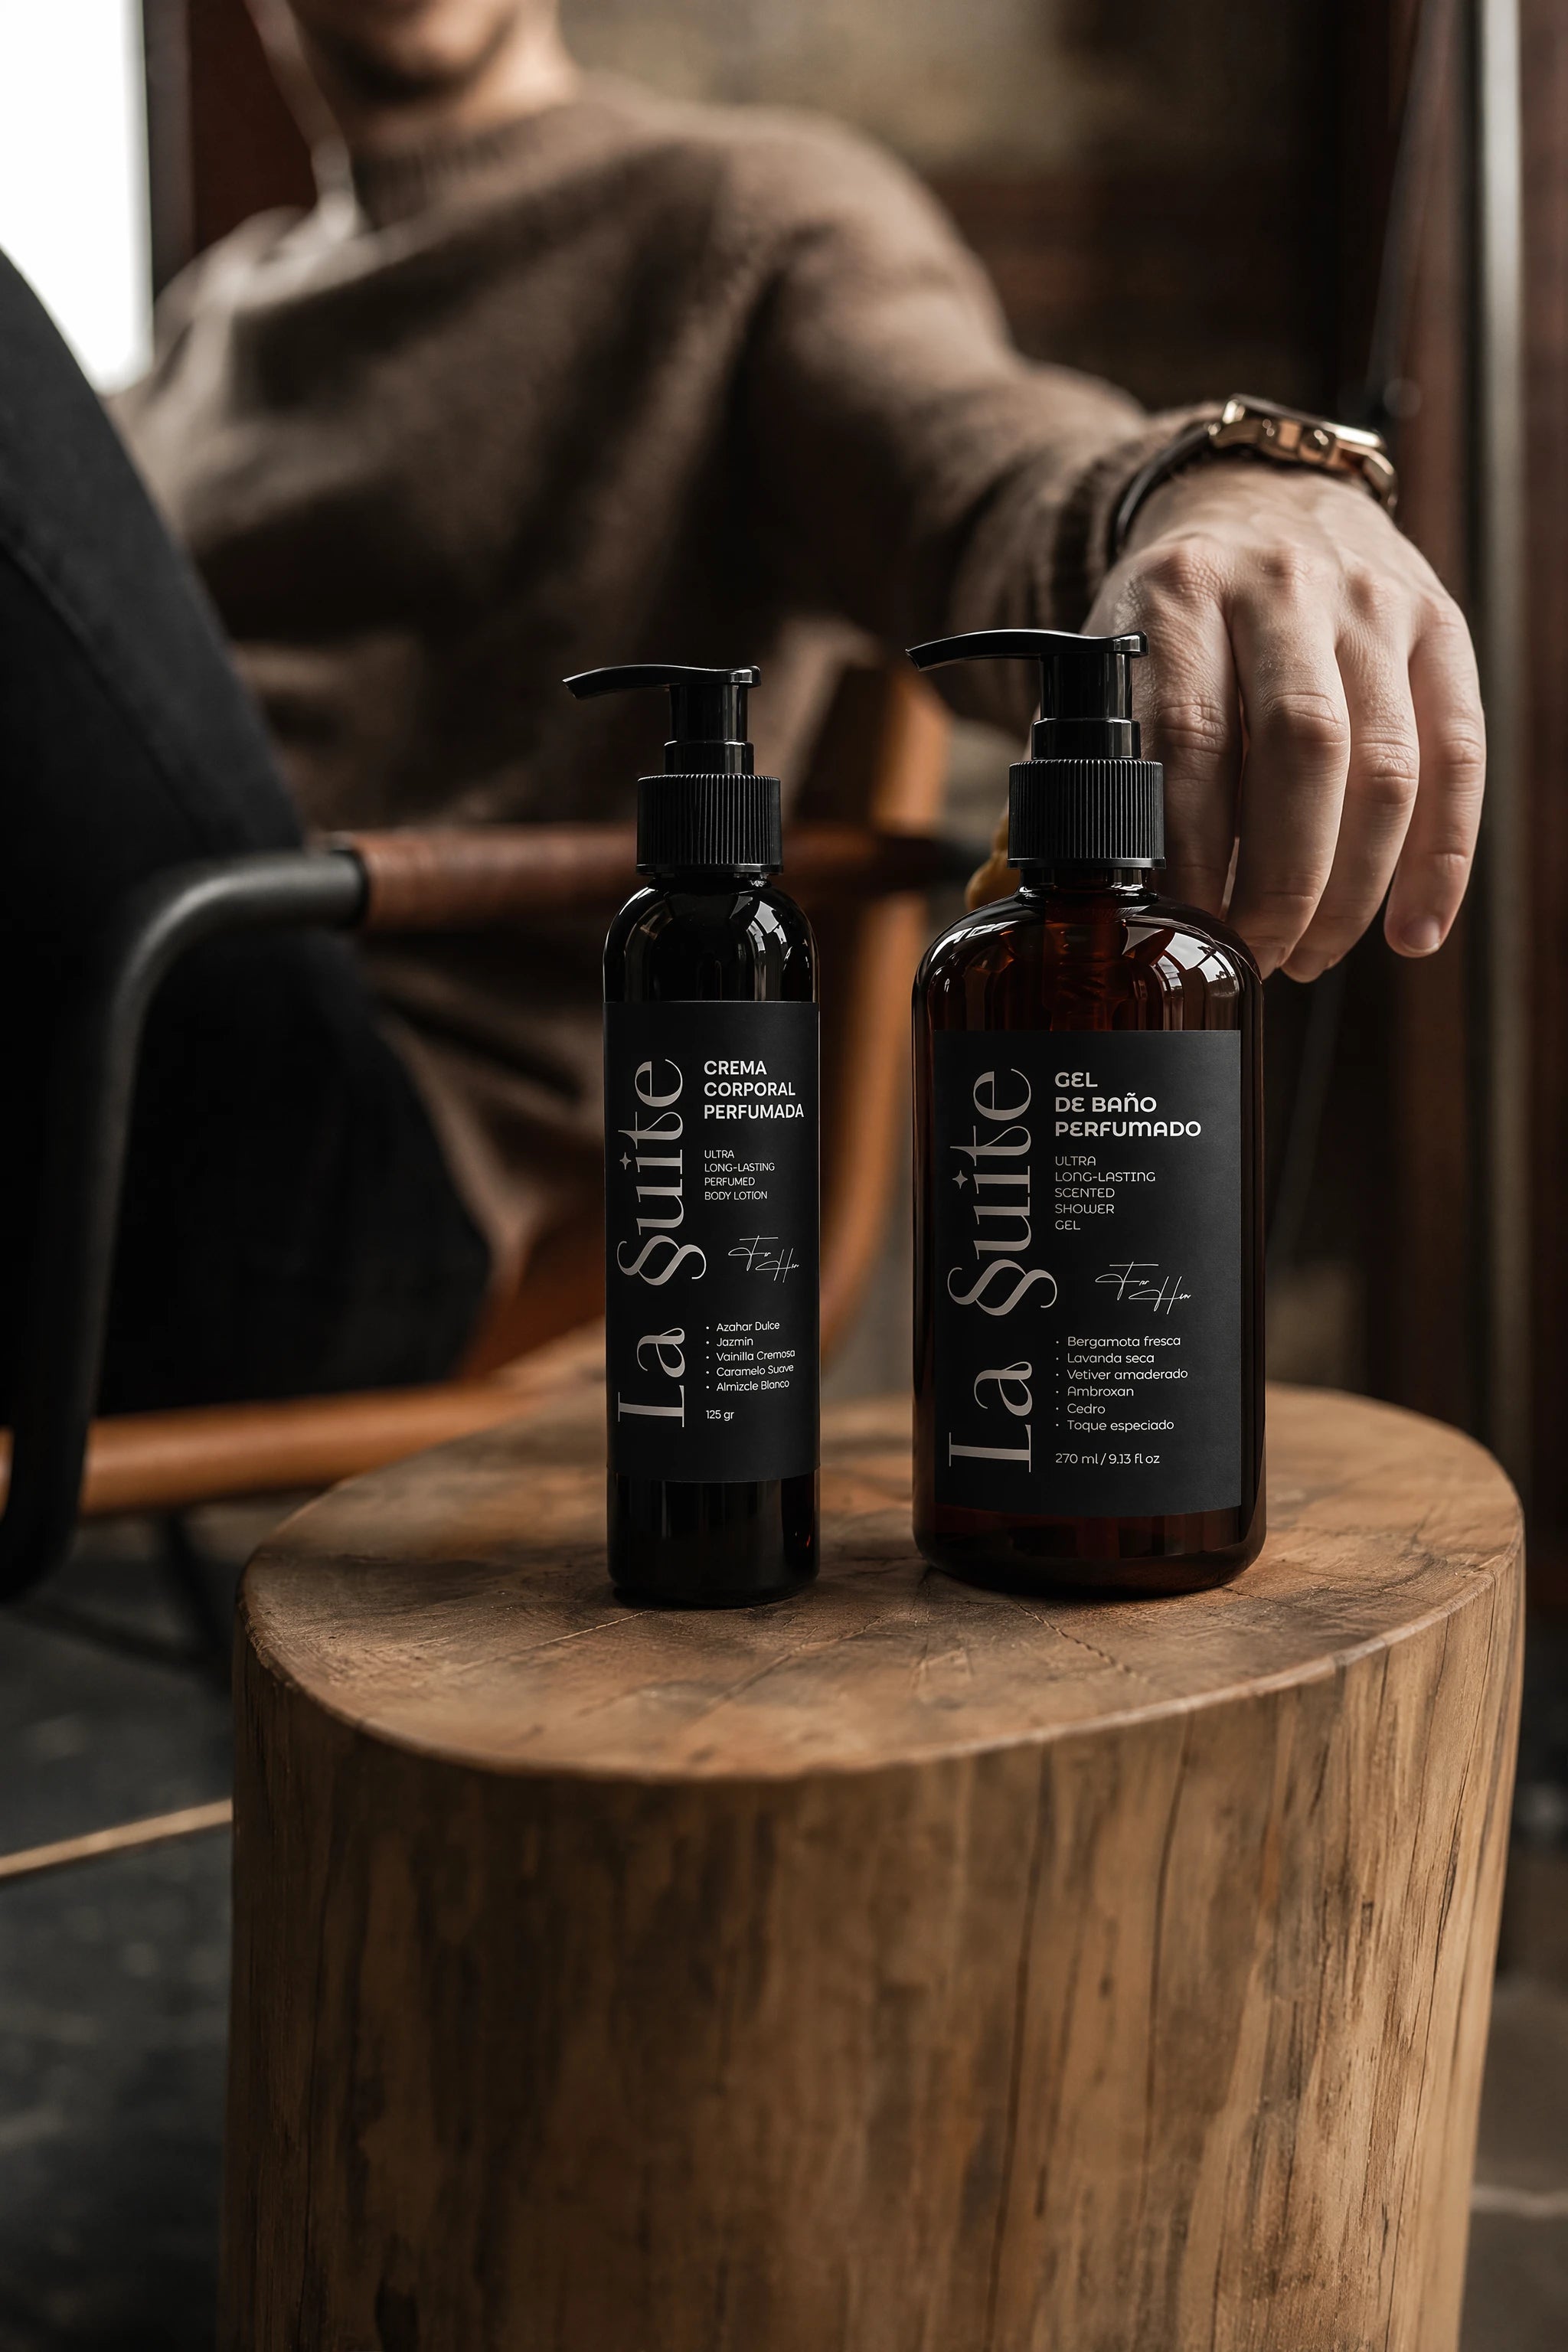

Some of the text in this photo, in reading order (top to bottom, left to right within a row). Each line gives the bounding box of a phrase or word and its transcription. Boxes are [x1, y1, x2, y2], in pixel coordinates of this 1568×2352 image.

[704, 1060, 768, 1076] CREMA
[1054, 1071, 1099, 1088] GEL
[704, 1081, 796, 1097] CORPORAL
[1055, 1092, 1157, 1113] DE BAÑO
[704, 1103, 805, 1119] PERFUMADA
[1055, 1120, 1202, 1137] PERFUMADO
[704, 1149, 735, 1159] ULTRA
[1055, 1155, 1096, 1166] ULTRA
[704, 1162, 776, 1173] LONG-LASTING
[704, 1177, 756, 1187] PERFUMED
[1055, 1171, 1156, 1182] LONG-LASTING
[704, 1191, 768, 1200] BODY LOTION
[1054, 1187, 1116, 1198] SCENTED
[1055, 1204, 1115, 1214] SHOWER
[1054, 1220, 1081, 1230] GEL
[617, 1059, 707, 1427] La Suite
[948, 1069, 1058, 1472] La Suite
[716, 1321, 780, 1332] Azahar Dulce
[716, 1336, 753, 1347] Jazmin
[1067, 1335, 1181, 1350] Bergamota fresca
[716, 1350, 795, 1361] Vainilla Cremosa
[1067, 1352, 1155, 1364] Lavanda seca
[716, 1364, 794, 1377] Caramelo Suave
[1067, 1368, 1188, 1380] Vetiver amaderado
[716, 1380, 790, 1392] Almizcle Blanco
[1067, 1385, 1134, 1397] Ambroxan
[1067, 1403, 1106, 1414] Cedro
[705, 1410, 735, 1422] 125 gr
[1067, 1419, 1174, 1433] Toque especiado
[1055, 1452, 1079, 1464] 270
